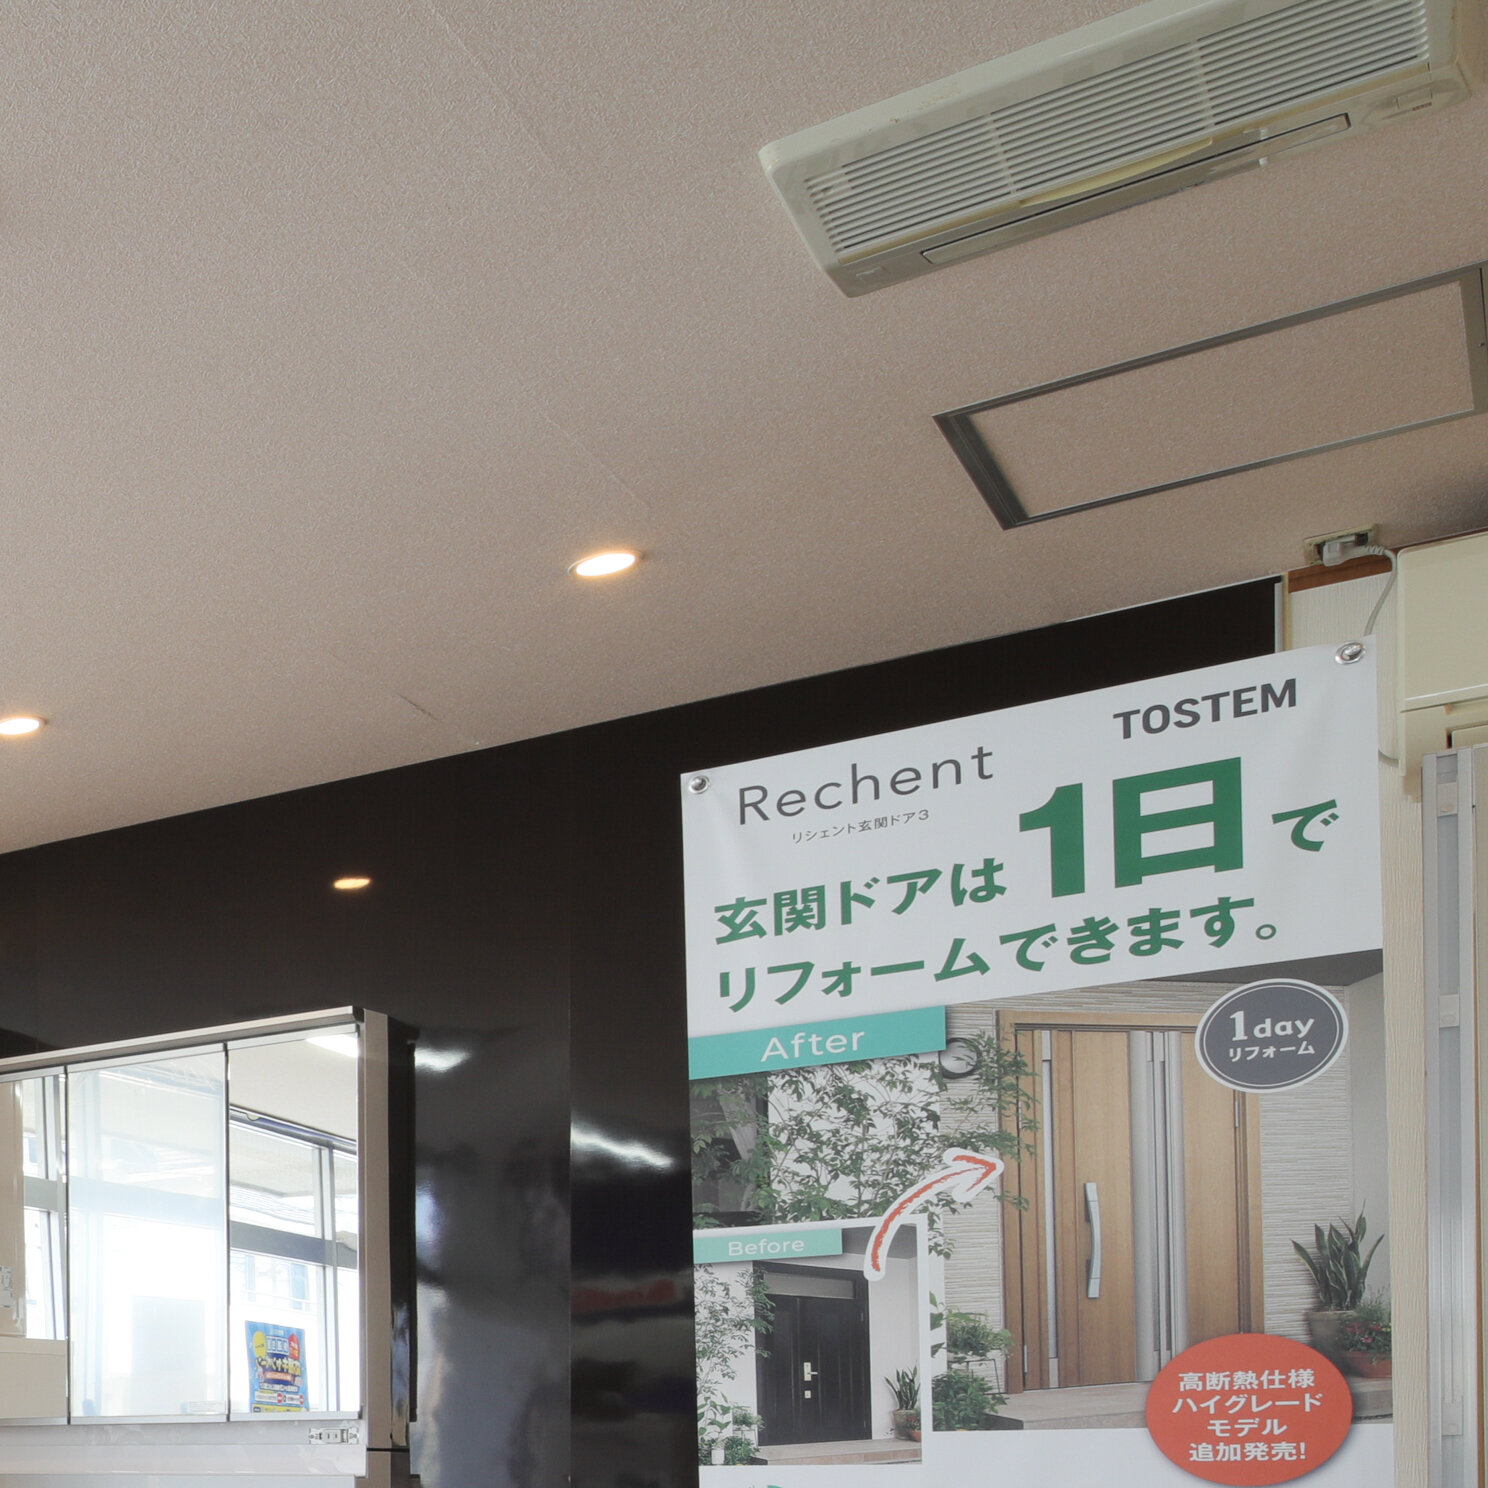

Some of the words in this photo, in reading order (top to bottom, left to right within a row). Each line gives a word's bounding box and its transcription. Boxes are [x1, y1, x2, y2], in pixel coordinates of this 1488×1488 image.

[1112, 678, 1299, 741] TOSTEM
[737, 745, 997, 826] Rechent
[791, 808, 931, 845] リシェント玄関ドア3
[714, 757, 1340, 946] 玄関ドアは1日で
[718, 896, 1279, 1012] リフォームできます。
[1228, 1010, 1315, 1042] 1day
[761, 1027, 866, 1064] After
[1228, 1039, 1316, 1063] リフォーム
[727, 1236, 806, 1256] Before
[1178, 1369, 1315, 1391] 高断熱仕様
[1172, 1394, 1323, 1414] ハイグレード
[1206, 1417, 1288, 1437] モデル
[1189, 1441, 1307, 1463] 追加発売!
